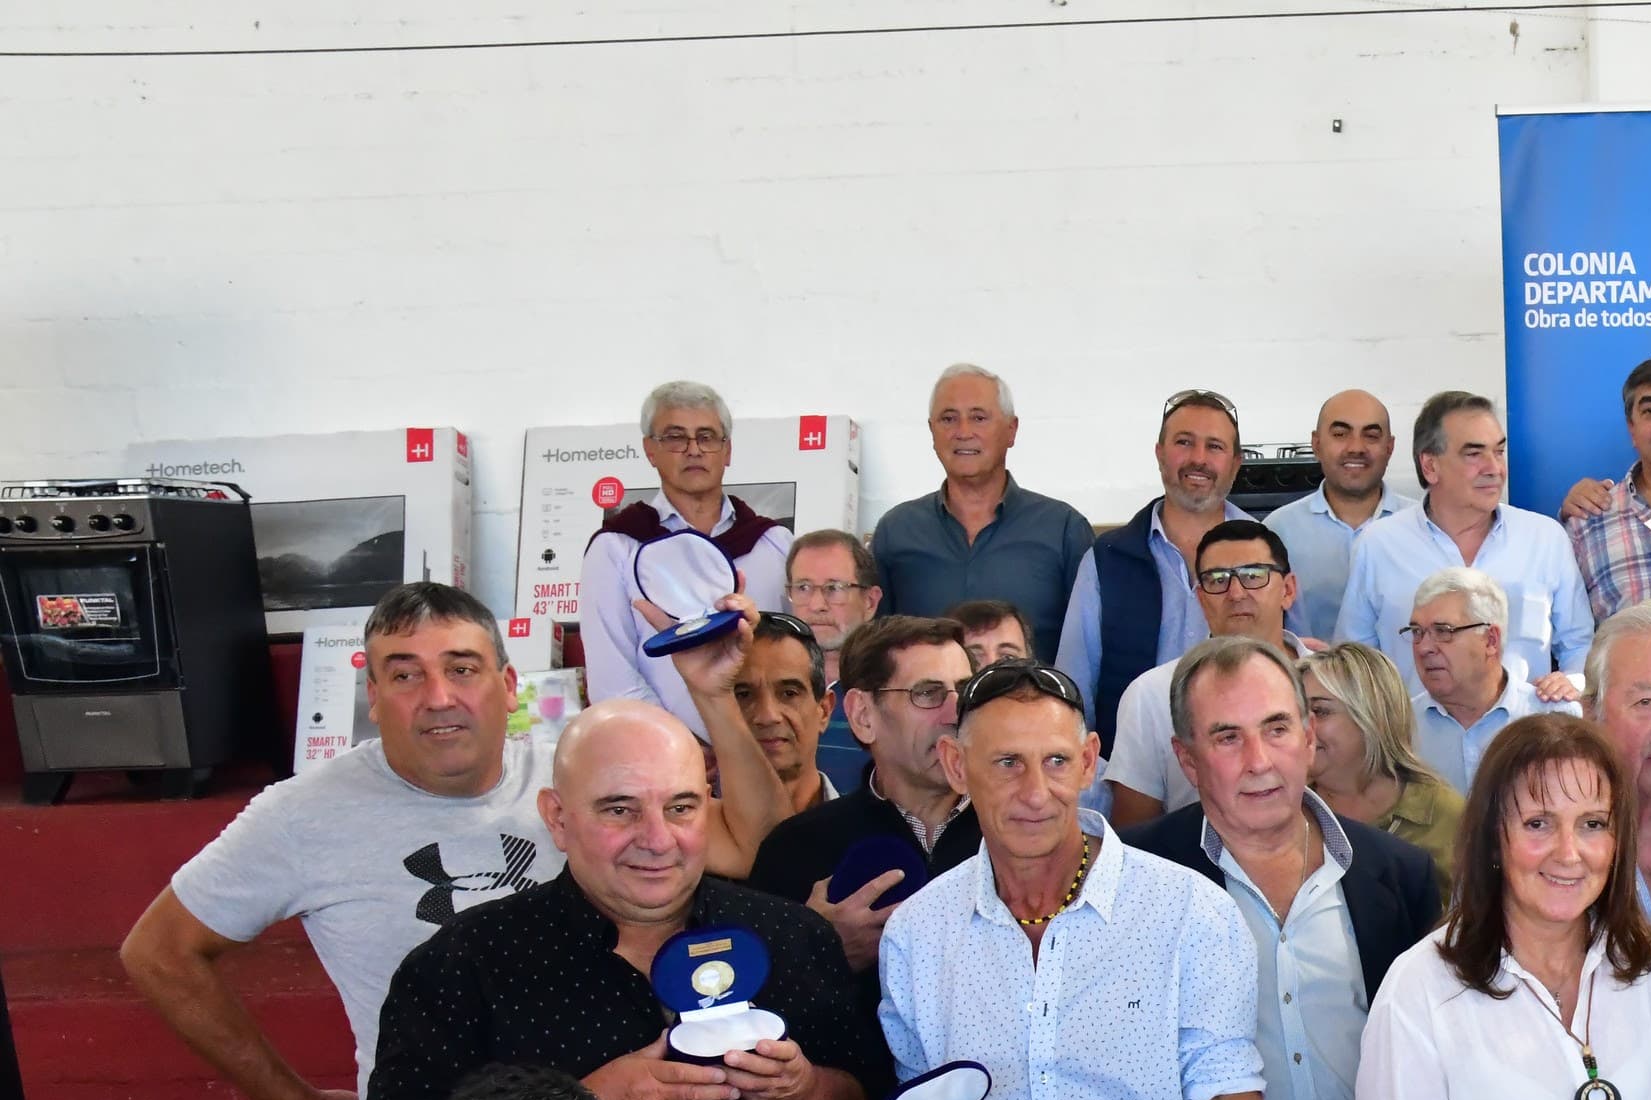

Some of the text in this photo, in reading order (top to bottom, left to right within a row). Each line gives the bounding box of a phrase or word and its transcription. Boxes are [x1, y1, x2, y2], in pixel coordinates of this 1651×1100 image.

[1524, 252, 1636, 276] COLONIA
[1525, 308, 1570, 328] Obra
[1574, 308, 1597, 327] de
[534, 583, 571, 598] SMART
[557, 600, 578, 613] FHD
[307, 735, 348, 747] SMART TV
